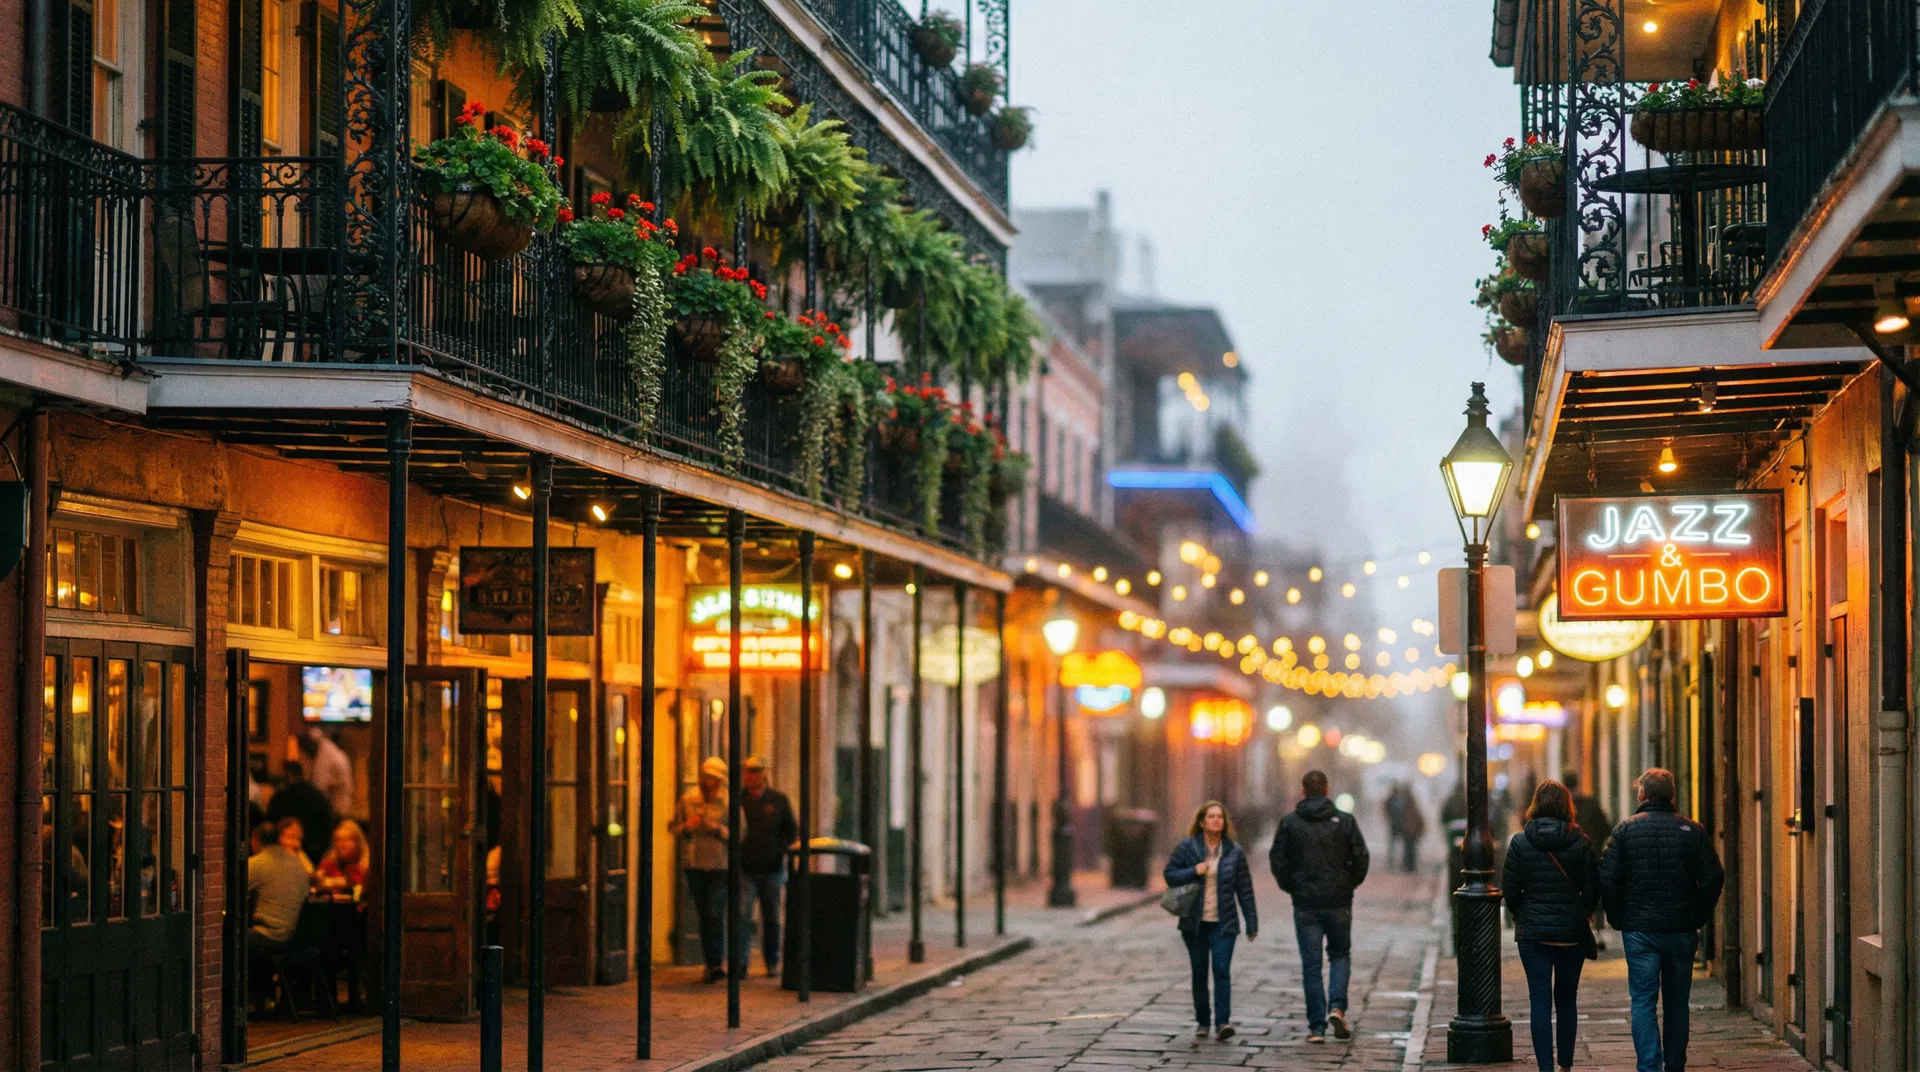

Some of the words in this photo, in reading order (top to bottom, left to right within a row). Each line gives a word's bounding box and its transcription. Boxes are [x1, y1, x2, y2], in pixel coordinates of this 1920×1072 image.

[1587, 503, 1752, 550] JAZZ
[1660, 543, 1682, 567] &
[1573, 567, 1771, 606] GUMBO
